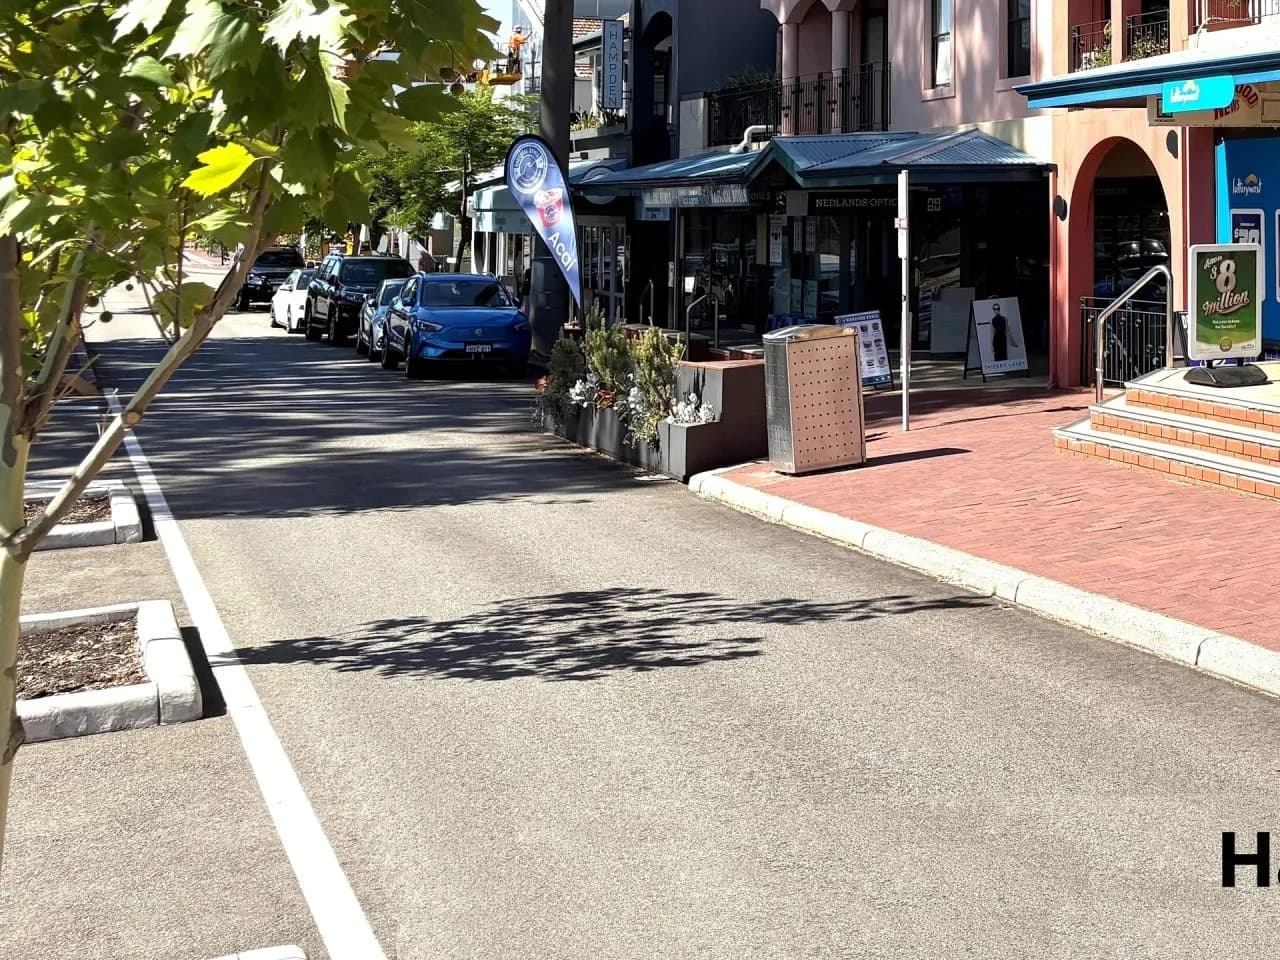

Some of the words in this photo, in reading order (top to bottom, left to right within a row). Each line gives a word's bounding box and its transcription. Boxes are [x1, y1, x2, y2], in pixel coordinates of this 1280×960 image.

[608, 30, 618, 106] HAMPDEN
[815, 198, 868, 208] NEDLANDS
[869, 197, 898, 207] OPTIC
[1202, 290, 1250, 315] million
